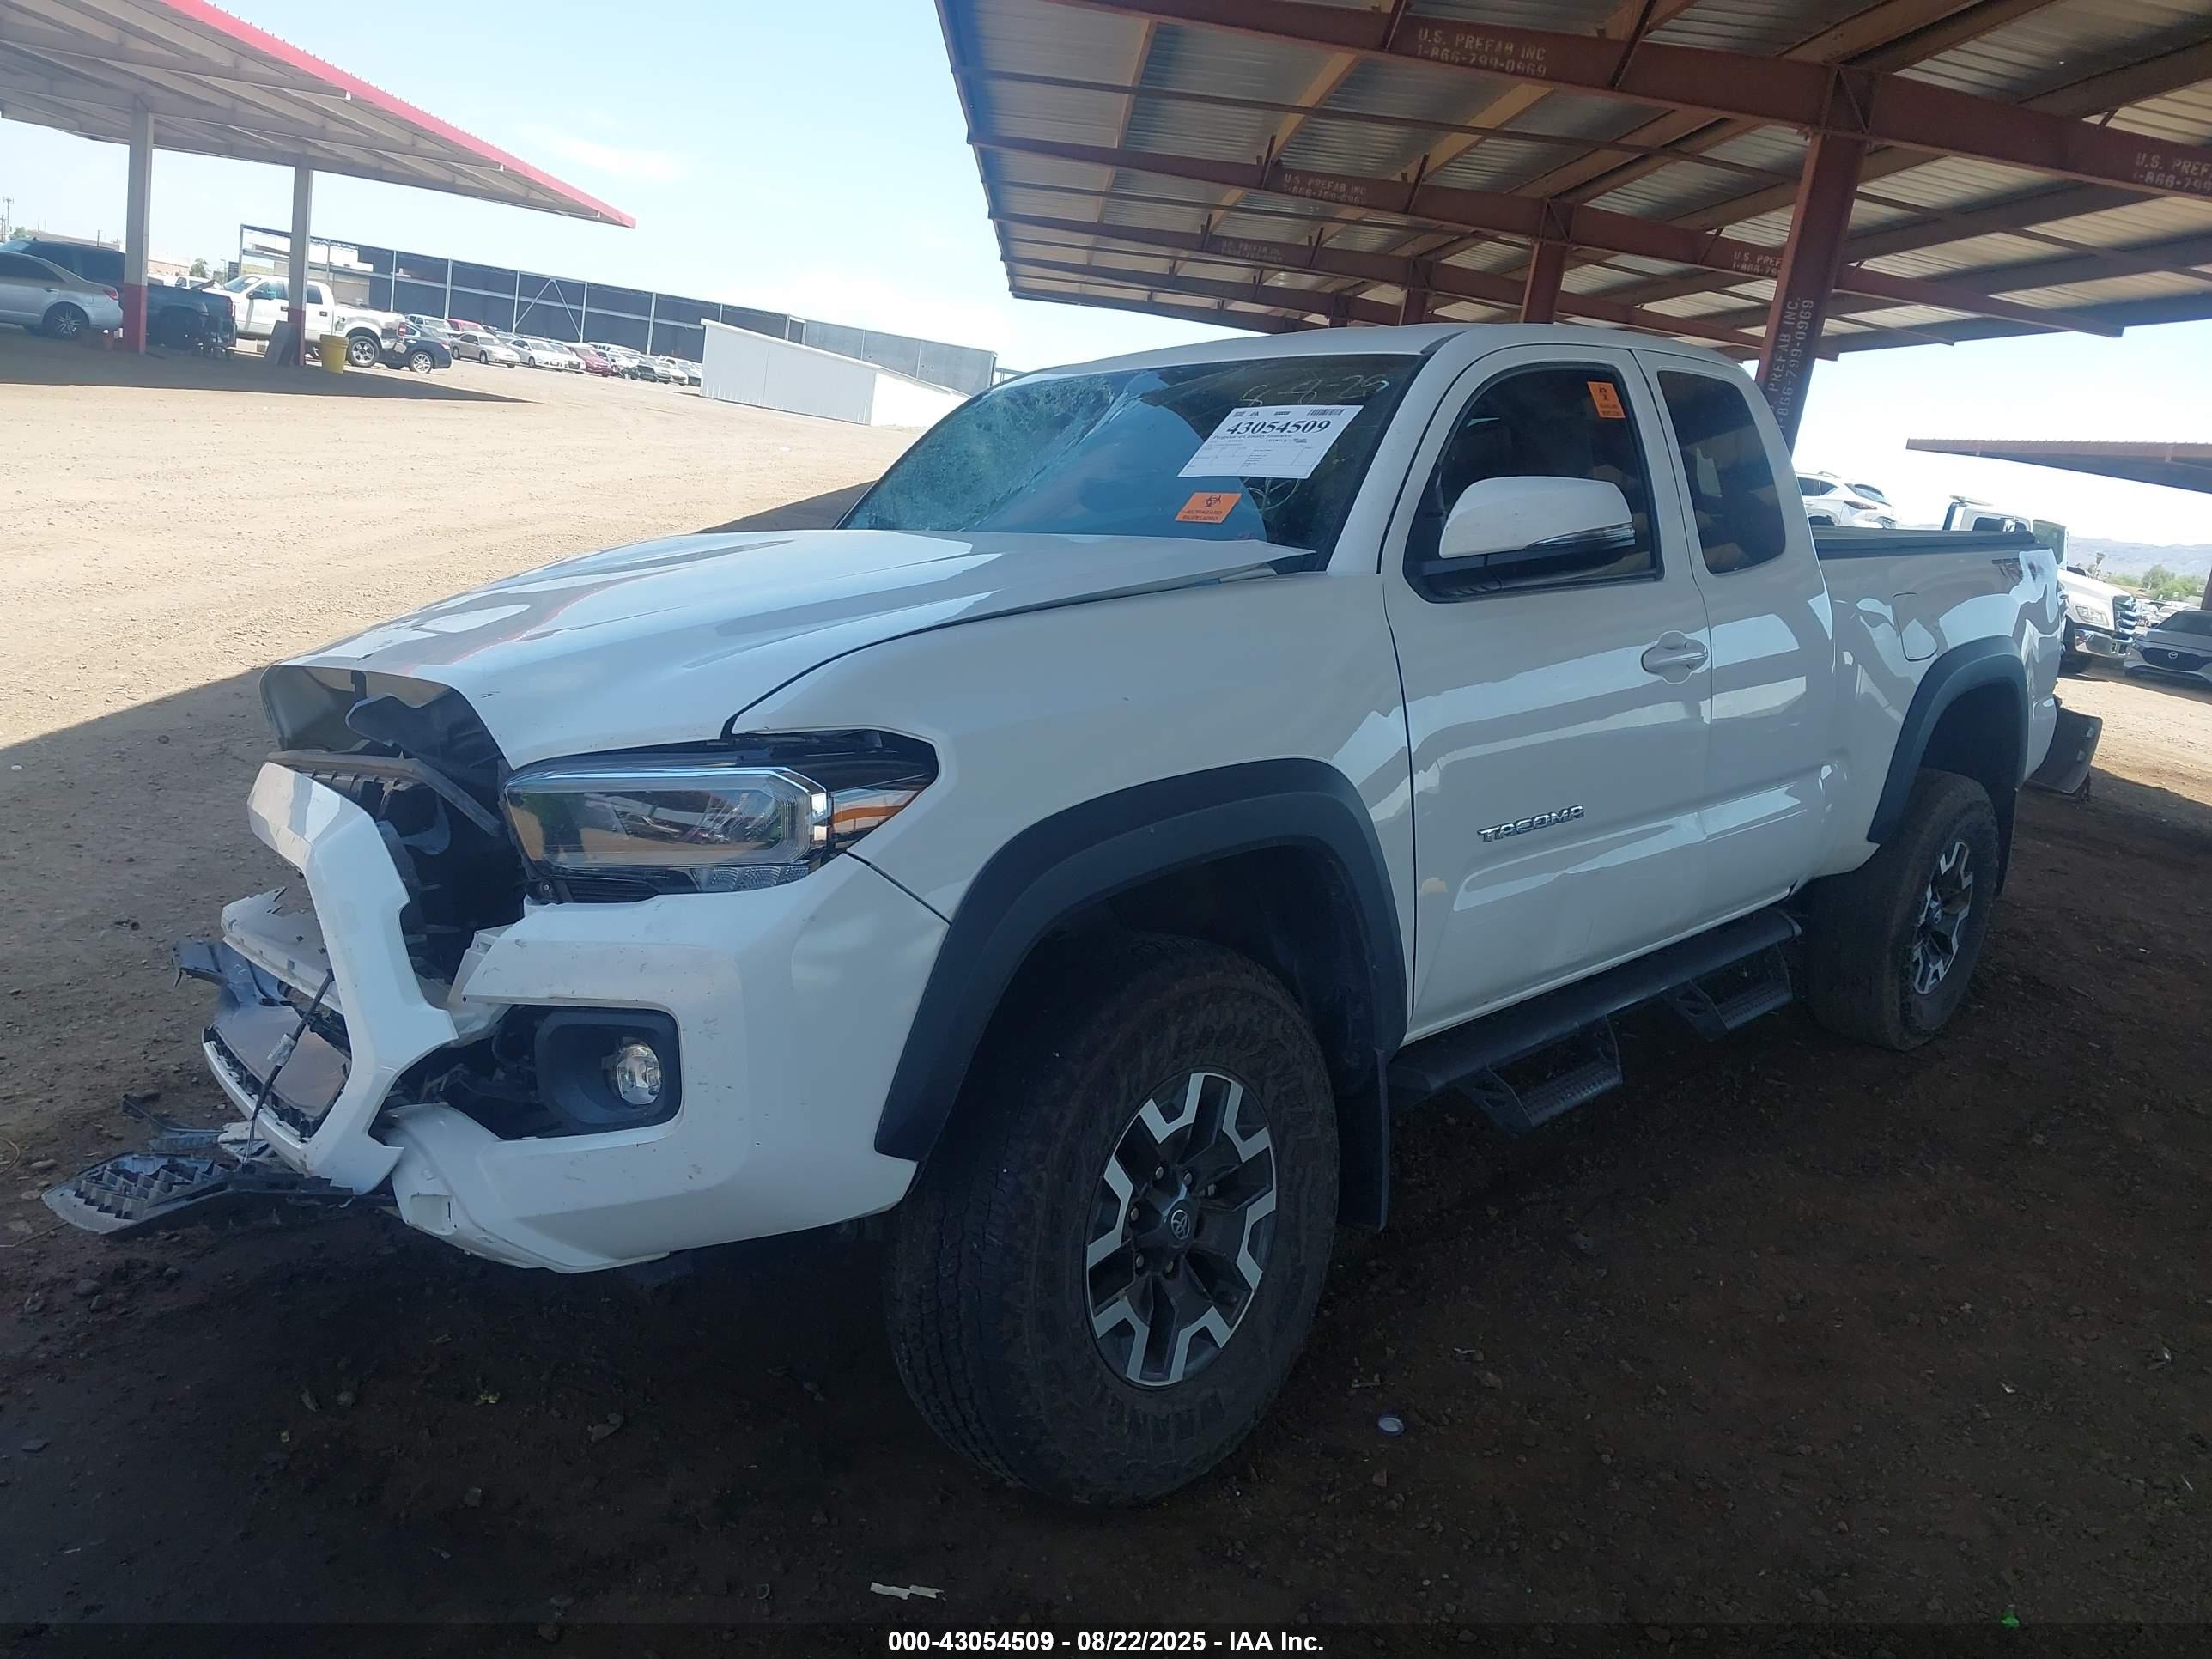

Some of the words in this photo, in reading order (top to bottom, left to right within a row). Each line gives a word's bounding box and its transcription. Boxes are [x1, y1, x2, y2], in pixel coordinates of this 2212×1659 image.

[1419, 27, 1446, 45] U.S.
[1455, 33, 1514, 55] PREFAB
[2171, 158, 2212, 178] PREF
[1768, 334, 1791, 392] PREFAB
[1226, 420, 1332, 434] 43054509
[1477, 804, 1585, 843] TACOMA
